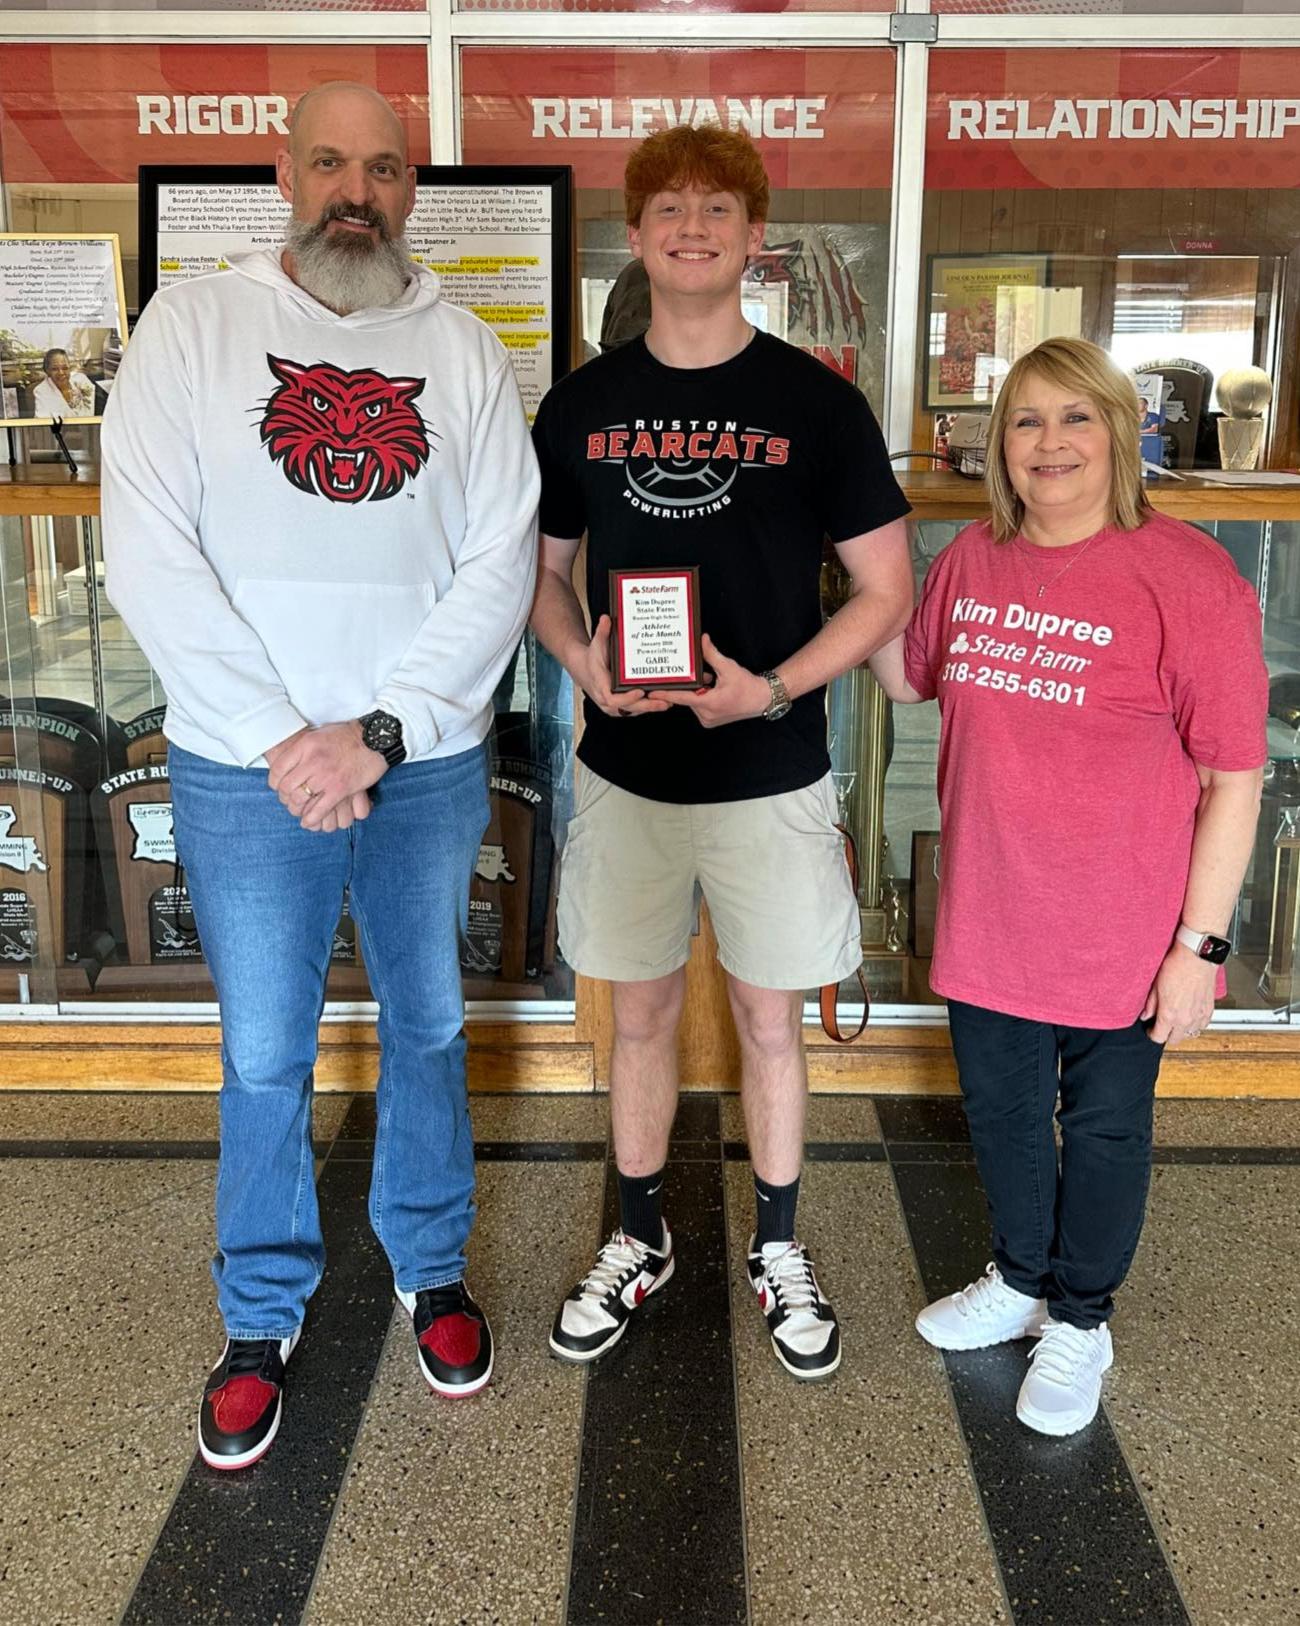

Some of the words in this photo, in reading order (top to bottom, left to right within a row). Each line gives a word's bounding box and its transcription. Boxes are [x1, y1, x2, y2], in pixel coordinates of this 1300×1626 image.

[136, 95, 290, 135] RIGOR
[531, 98, 826, 138] RELEVANCE
[948, 100, 1300, 139] RELATIONSHIP
[1186, 241, 1213, 249] DONNA
[635, 419, 737, 431] RUSTON
[587, 431, 790, 465] BEARCATS
[623, 489, 732, 519] POWERLIFTING
[952, 598, 997, 625] Kim
[1003, 603, 1113, 646] Dupree
[646, 656, 670, 664] GABE
[970, 634, 1027, 663] State
[1030, 645, 1085, 673] Farm
[631, 666, 684, 674] MIDDLETON
[942, 662, 1086, 706] 318-255-6301
[101, 767, 147, 793] STATE
[470, 901, 491, 910] 2019
